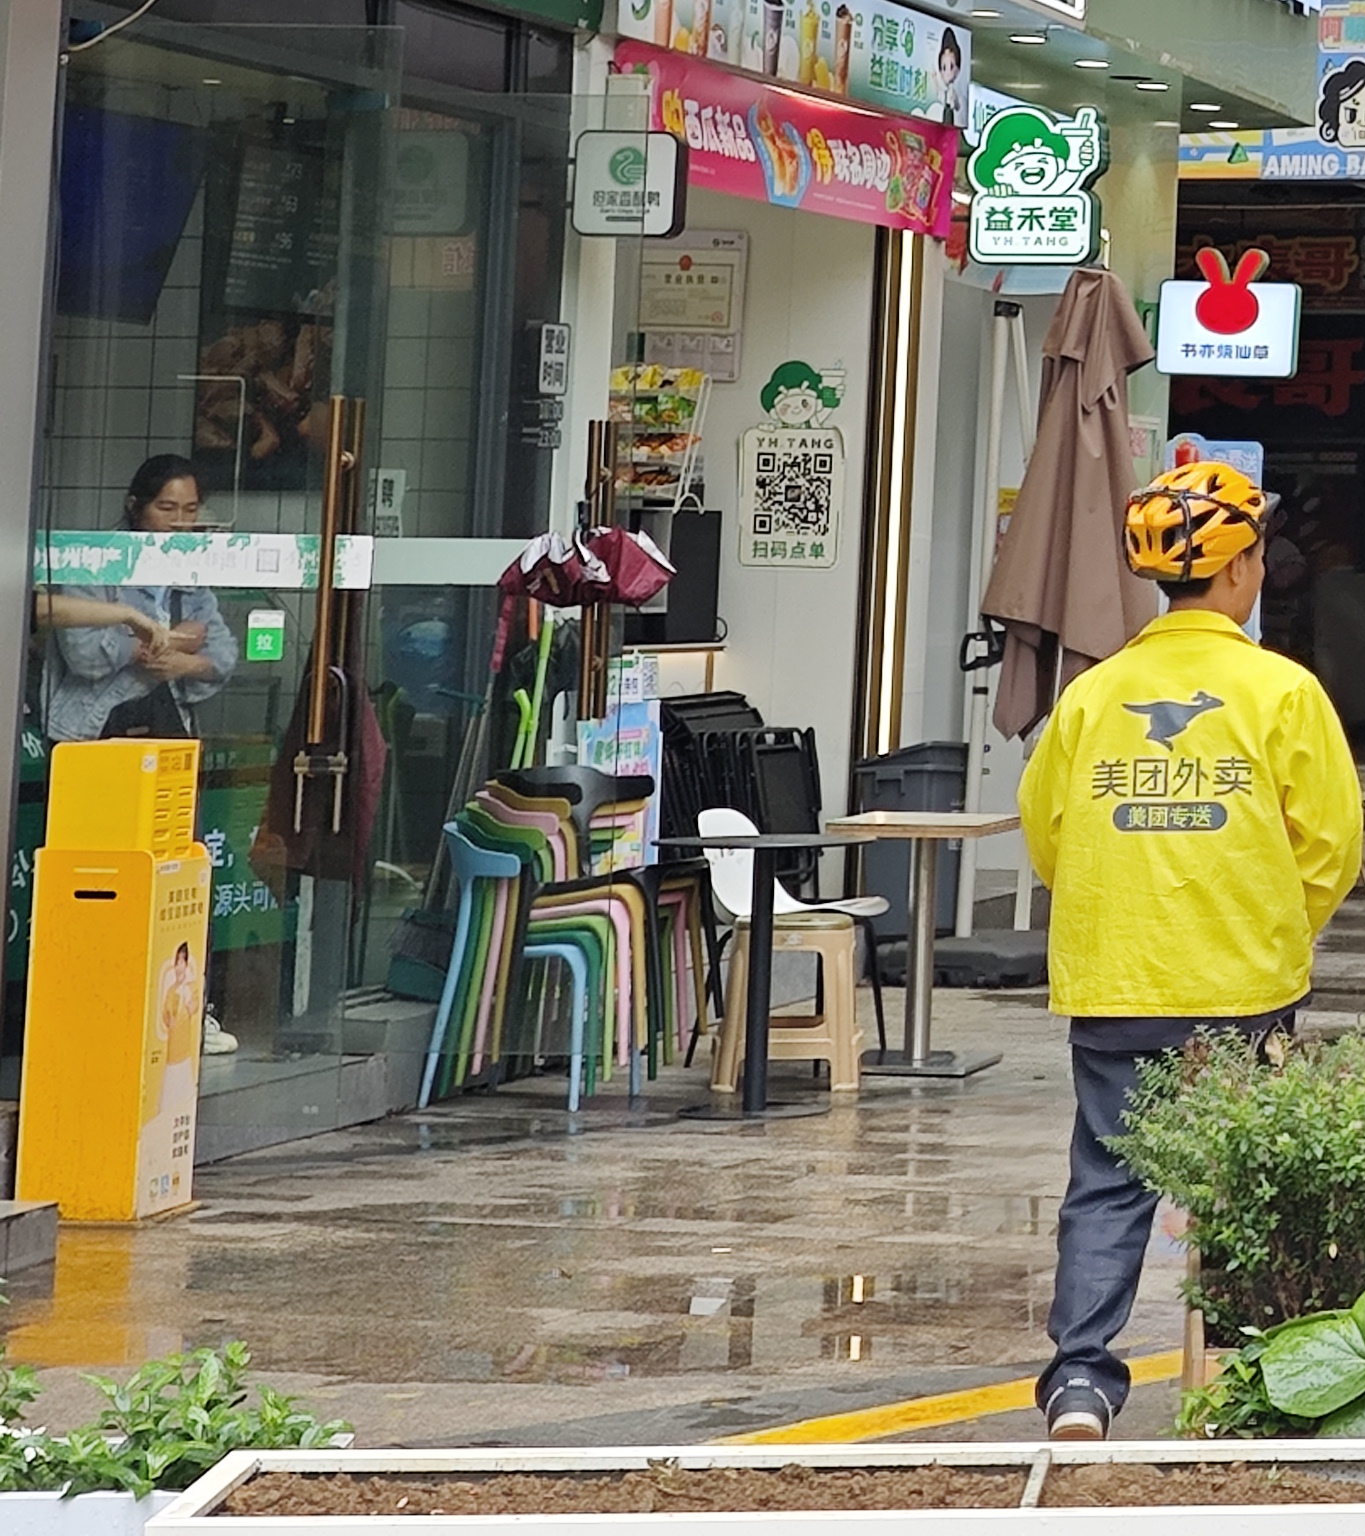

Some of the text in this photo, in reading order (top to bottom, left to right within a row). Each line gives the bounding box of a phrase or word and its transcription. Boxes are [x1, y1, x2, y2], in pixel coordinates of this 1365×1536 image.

[1264, 155, 1338, 177] AMING
[985, 205, 1079, 233] 益禾堂
[1180, 343, 1270, 361] 书亦烧仙草
[753, 539, 826, 560] 扫码点单
[256, 634, 273, 651] 拉
[1091, 757, 1254, 799] 美团外卖
[1126, 805, 1213, 829] 美团专送
